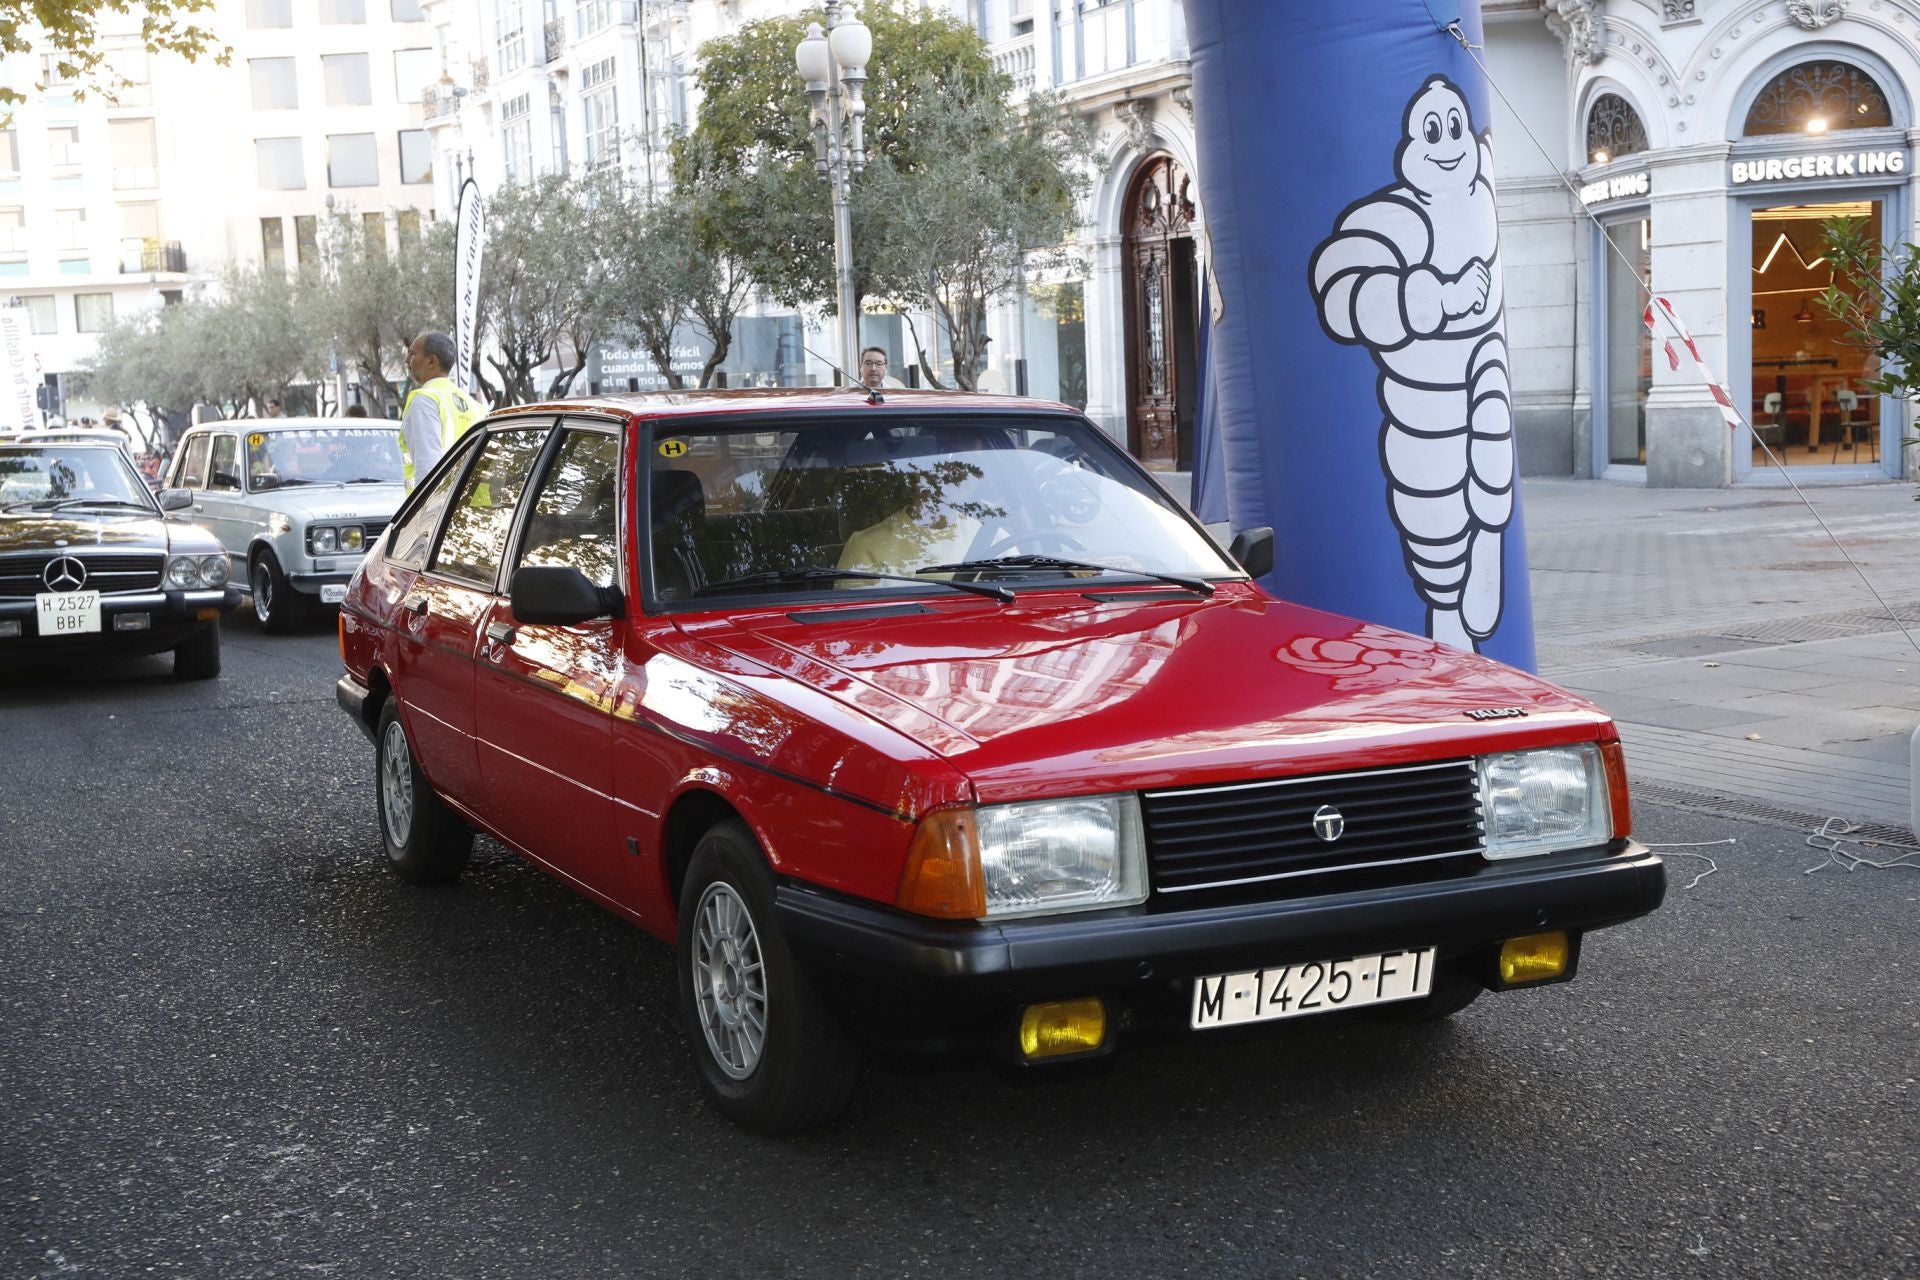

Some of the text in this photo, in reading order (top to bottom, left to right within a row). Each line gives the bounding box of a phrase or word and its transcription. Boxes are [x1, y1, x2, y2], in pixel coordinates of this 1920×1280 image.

[1731, 155, 1833, 184] BURGER
[1610, 173, 1648, 198] KING
[465, 193, 480, 281] Castilla
[464, 284, 473, 307] de
[600, 349, 629, 360] Todo
[674, 346, 701, 357] fácil
[601, 361, 645, 374] cuando
[602, 376, 613, 387] el
[282, 430, 340, 439] SEAT
[665, 443, 681, 454] H
[43, 596, 94, 611] H 2527
[57, 615, 86, 629] BBF
[1463, 707, 1528, 721] TALBOT
